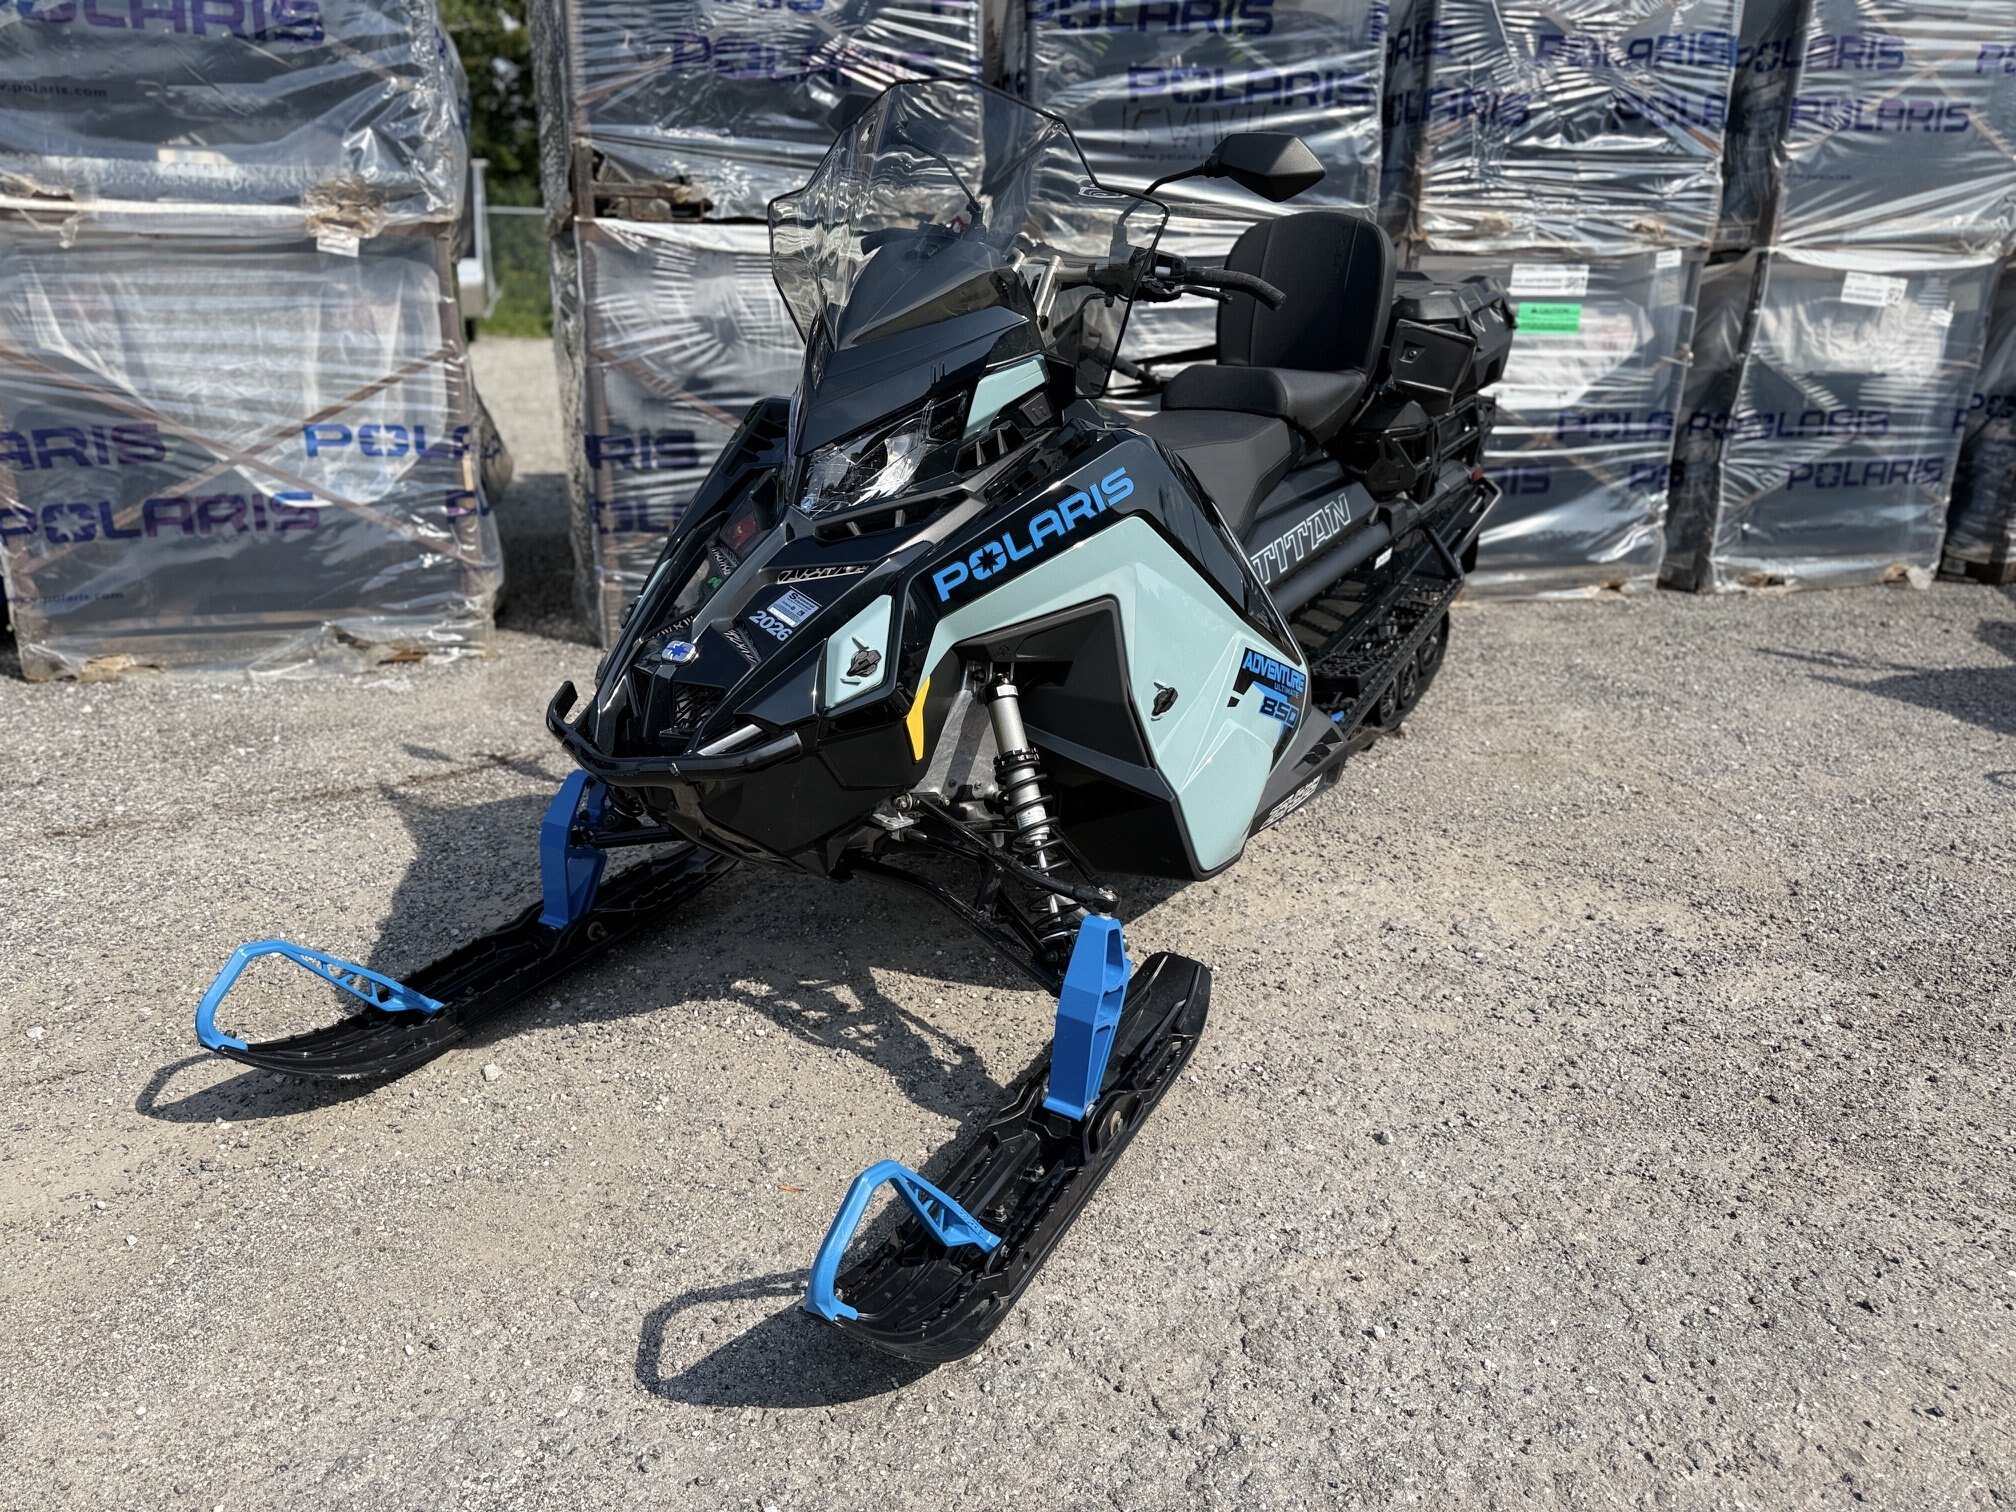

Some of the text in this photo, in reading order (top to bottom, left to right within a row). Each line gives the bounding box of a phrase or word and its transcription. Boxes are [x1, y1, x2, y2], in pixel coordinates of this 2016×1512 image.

[1127, 66, 1373, 106] POLARIS
[1786, 457, 1944, 491] POLARIS
[932, 466, 1136, 602] POLARIS
[1250, 492, 1352, 586] TITAN
[749, 610, 793, 642] 2026
[1242, 650, 1305, 693] ADVENTURE
[1260, 695, 1300, 728] 850
